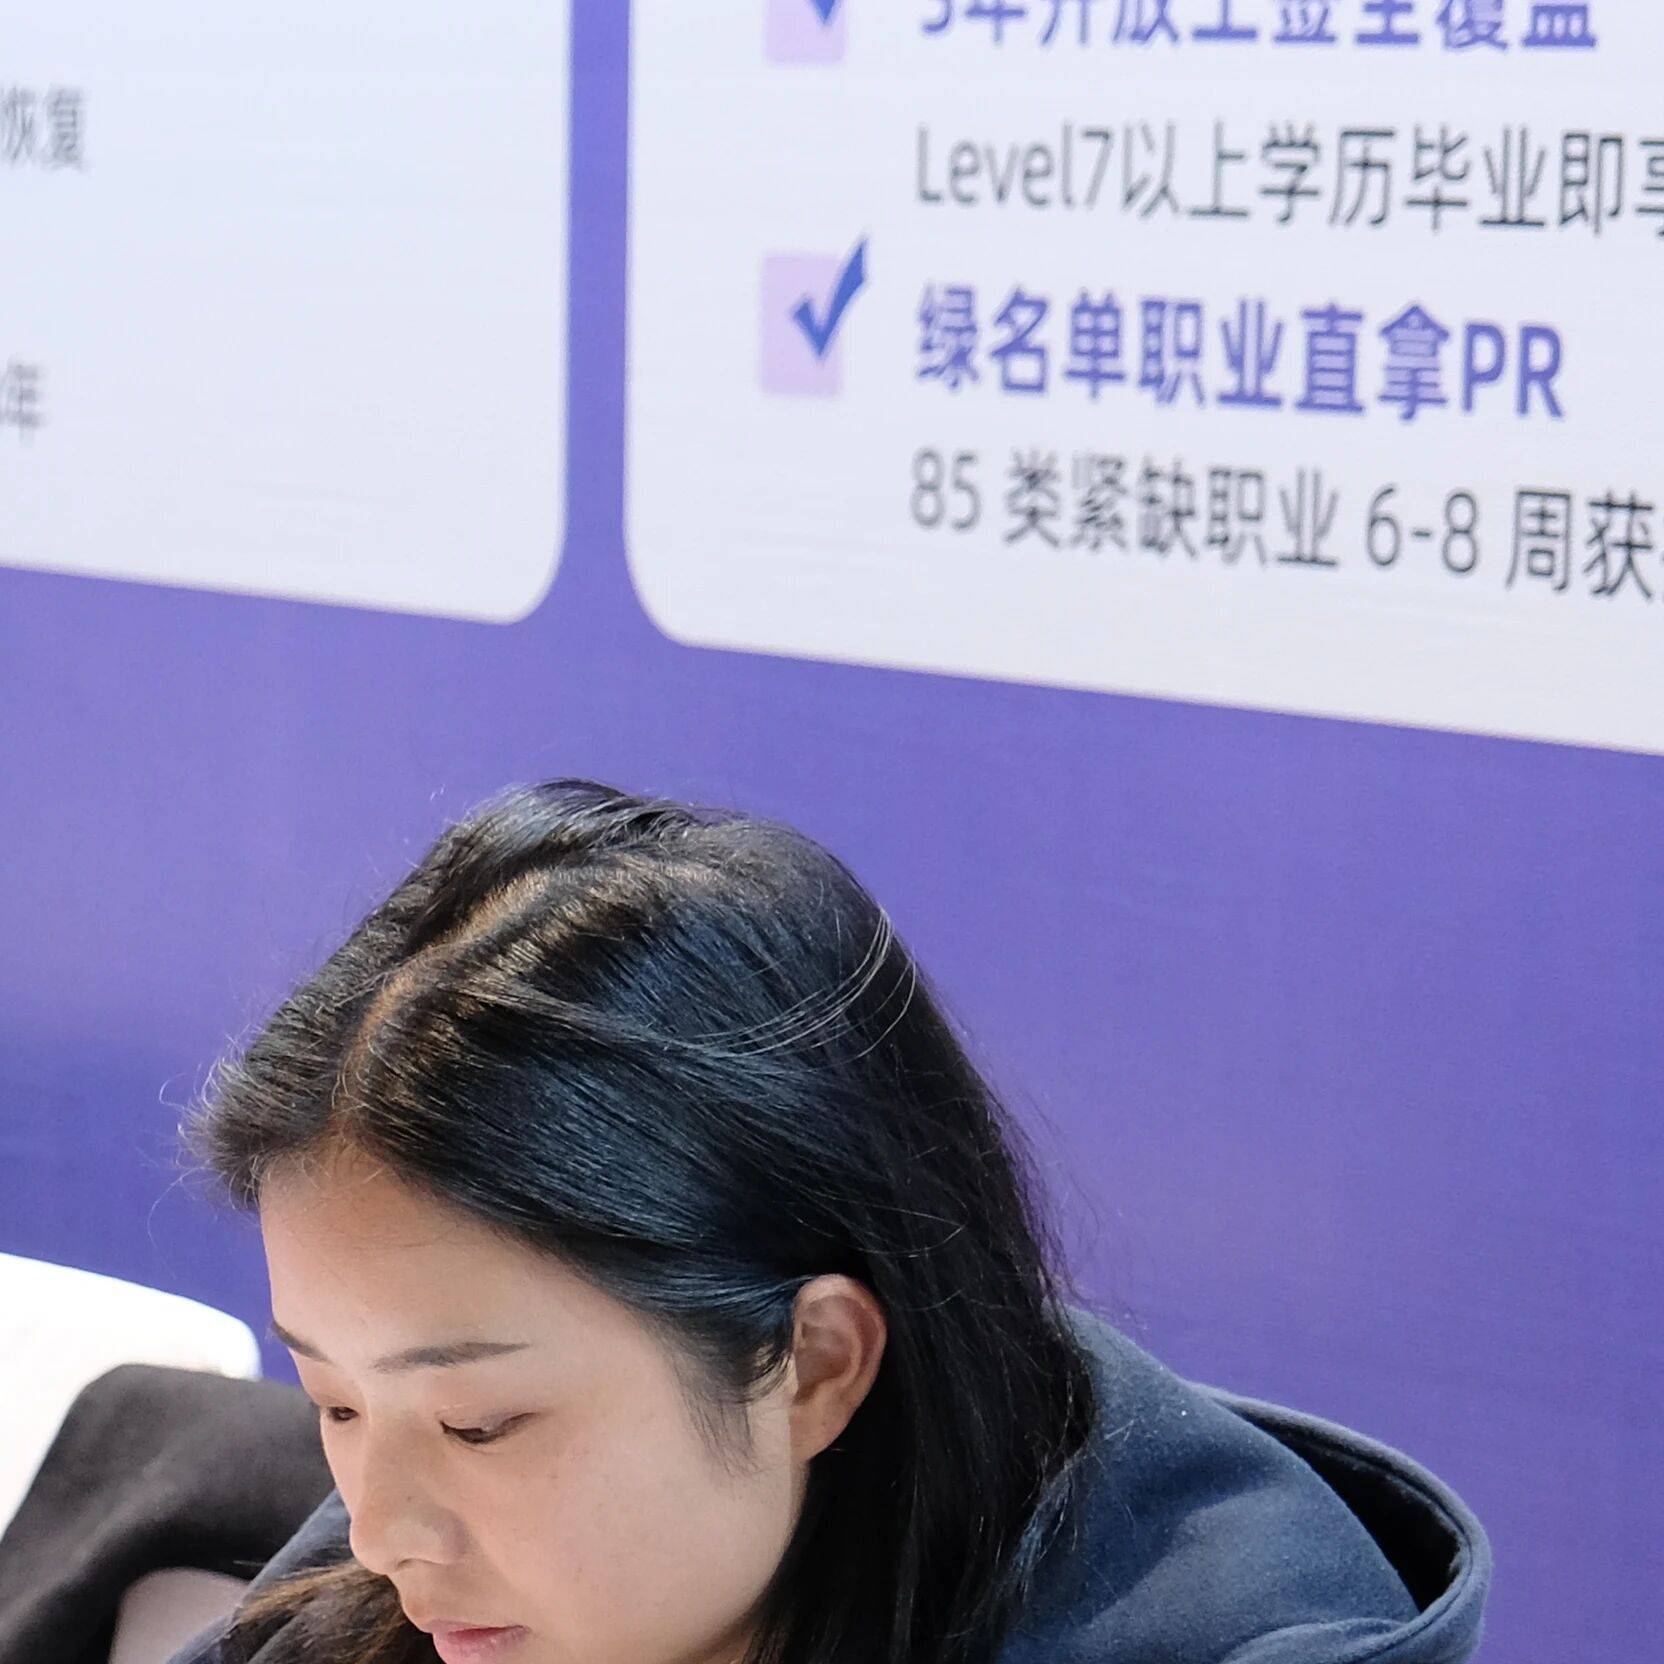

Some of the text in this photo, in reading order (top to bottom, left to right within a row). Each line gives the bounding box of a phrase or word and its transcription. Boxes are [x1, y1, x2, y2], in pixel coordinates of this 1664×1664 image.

[915, 283, 1565, 424] 绿名单职业直拿PR
[911, 448, 1664, 603] 85 类紧缺职业 6-8 周获
